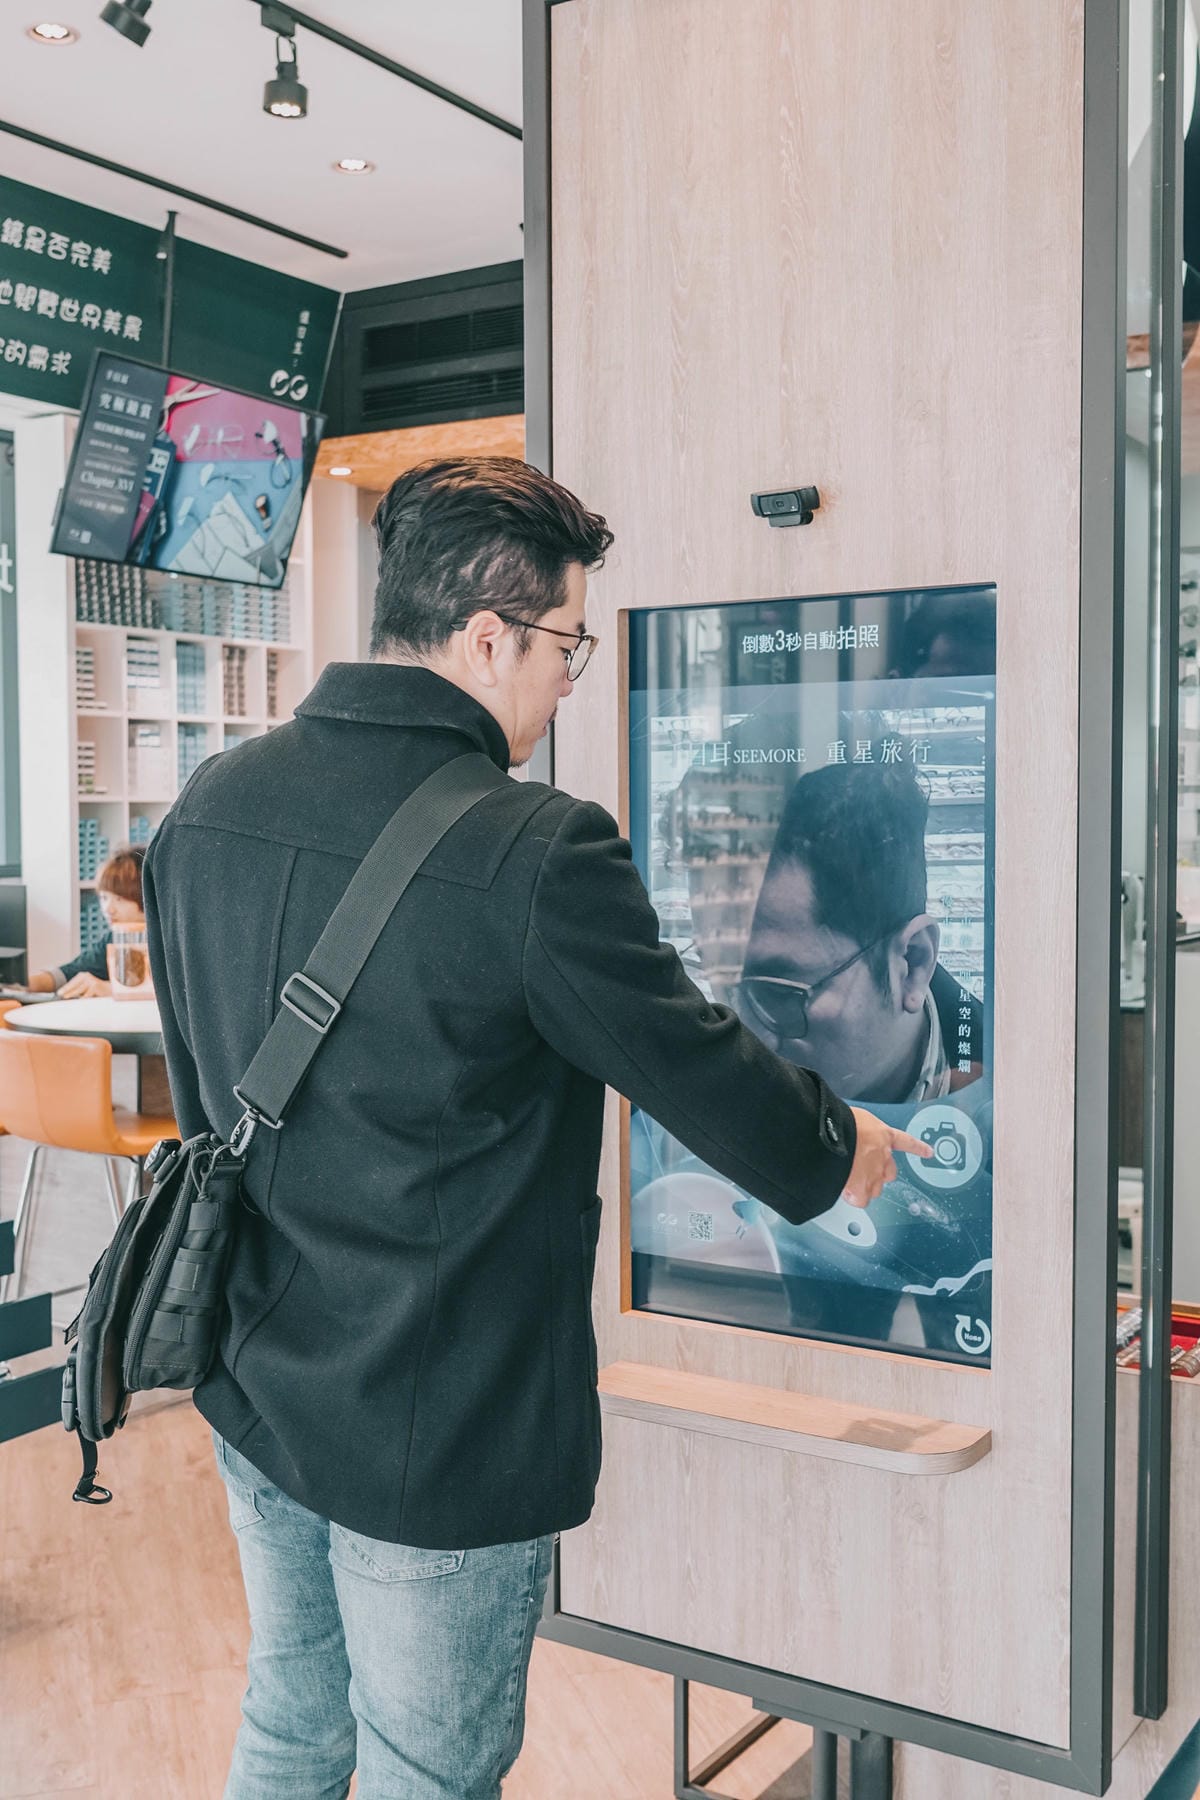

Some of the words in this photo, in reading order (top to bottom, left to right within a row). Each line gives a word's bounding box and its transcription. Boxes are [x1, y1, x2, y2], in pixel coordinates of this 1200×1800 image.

[0, 337, 72, 375] 的需求
[742, 624, 879, 654] 倒數3秒自動拍照
[733, 748, 807, 764] SEEMORE
[826, 739, 931, 765] 重星旅行
